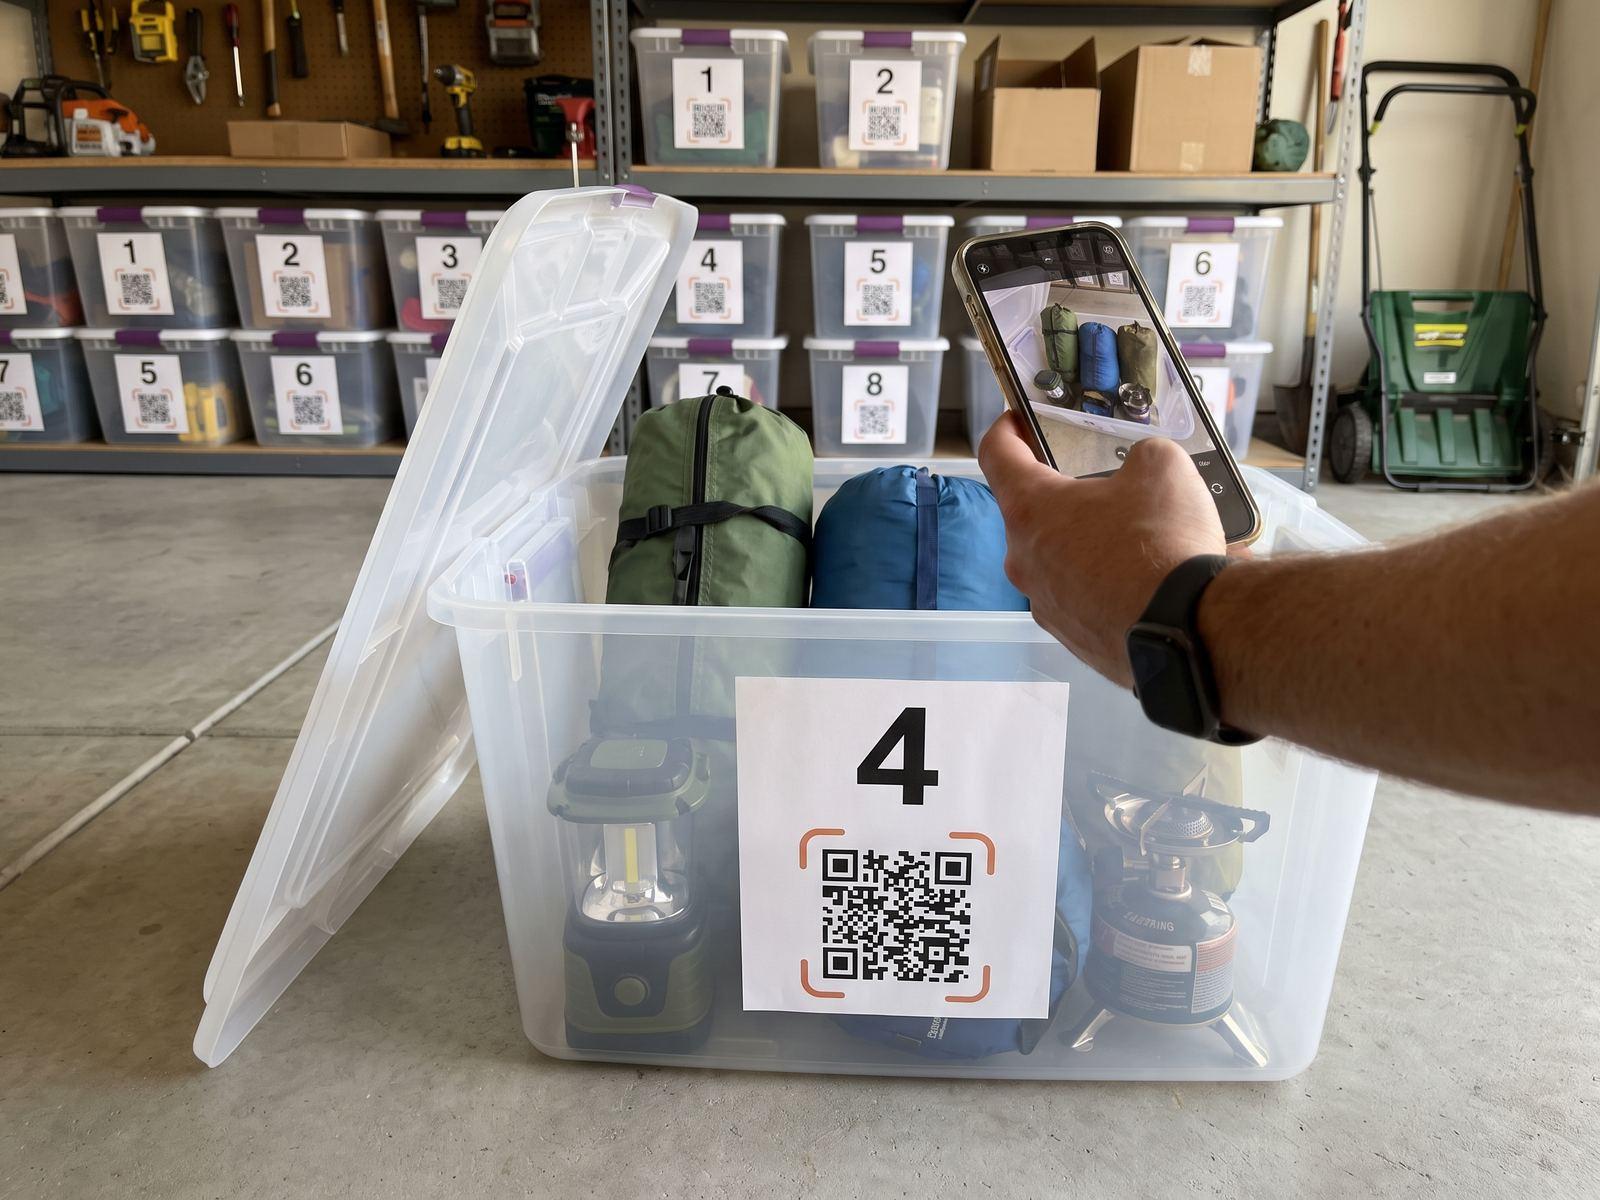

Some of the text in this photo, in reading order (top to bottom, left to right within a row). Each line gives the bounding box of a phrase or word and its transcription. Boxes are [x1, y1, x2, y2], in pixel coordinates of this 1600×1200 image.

[701, 67, 712, 93] 1
[877, 69, 894, 94] 2
[123, 240, 136, 264] 1
[282, 242, 300, 267] 2
[442, 244, 459, 269] 3
[700, 248, 717, 273] 4
[870, 249, 887, 274] 5
[1195, 251, 1212, 276] 6
[140, 362, 158, 386] 5
[295, 362, 313, 387] 6
[703, 371, 719, 395] 7
[866, 373, 883, 397] 8
[857, 707, 939, 806] 4
